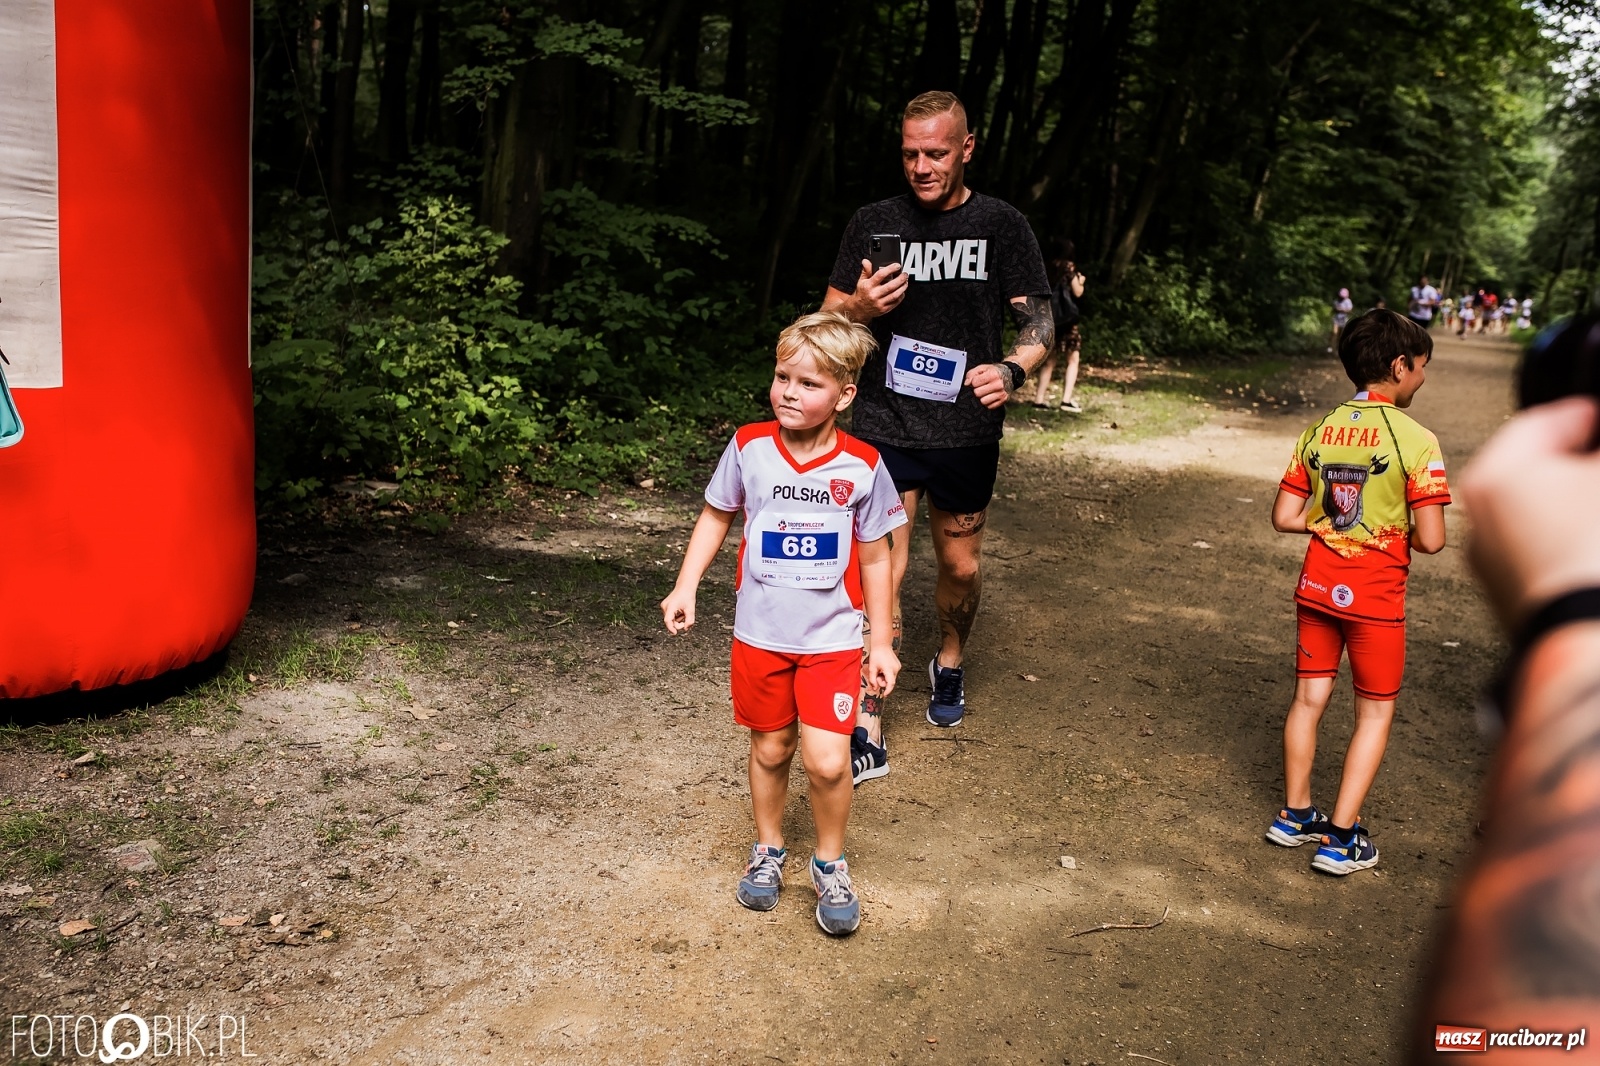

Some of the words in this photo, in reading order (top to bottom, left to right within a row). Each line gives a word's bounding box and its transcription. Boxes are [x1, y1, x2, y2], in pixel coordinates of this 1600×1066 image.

[912, 355, 938, 374] 69
[1320, 426, 1381, 447] RAFAŁ
[773, 485, 830, 505] POLSKA
[782, 536, 817, 557] 68
